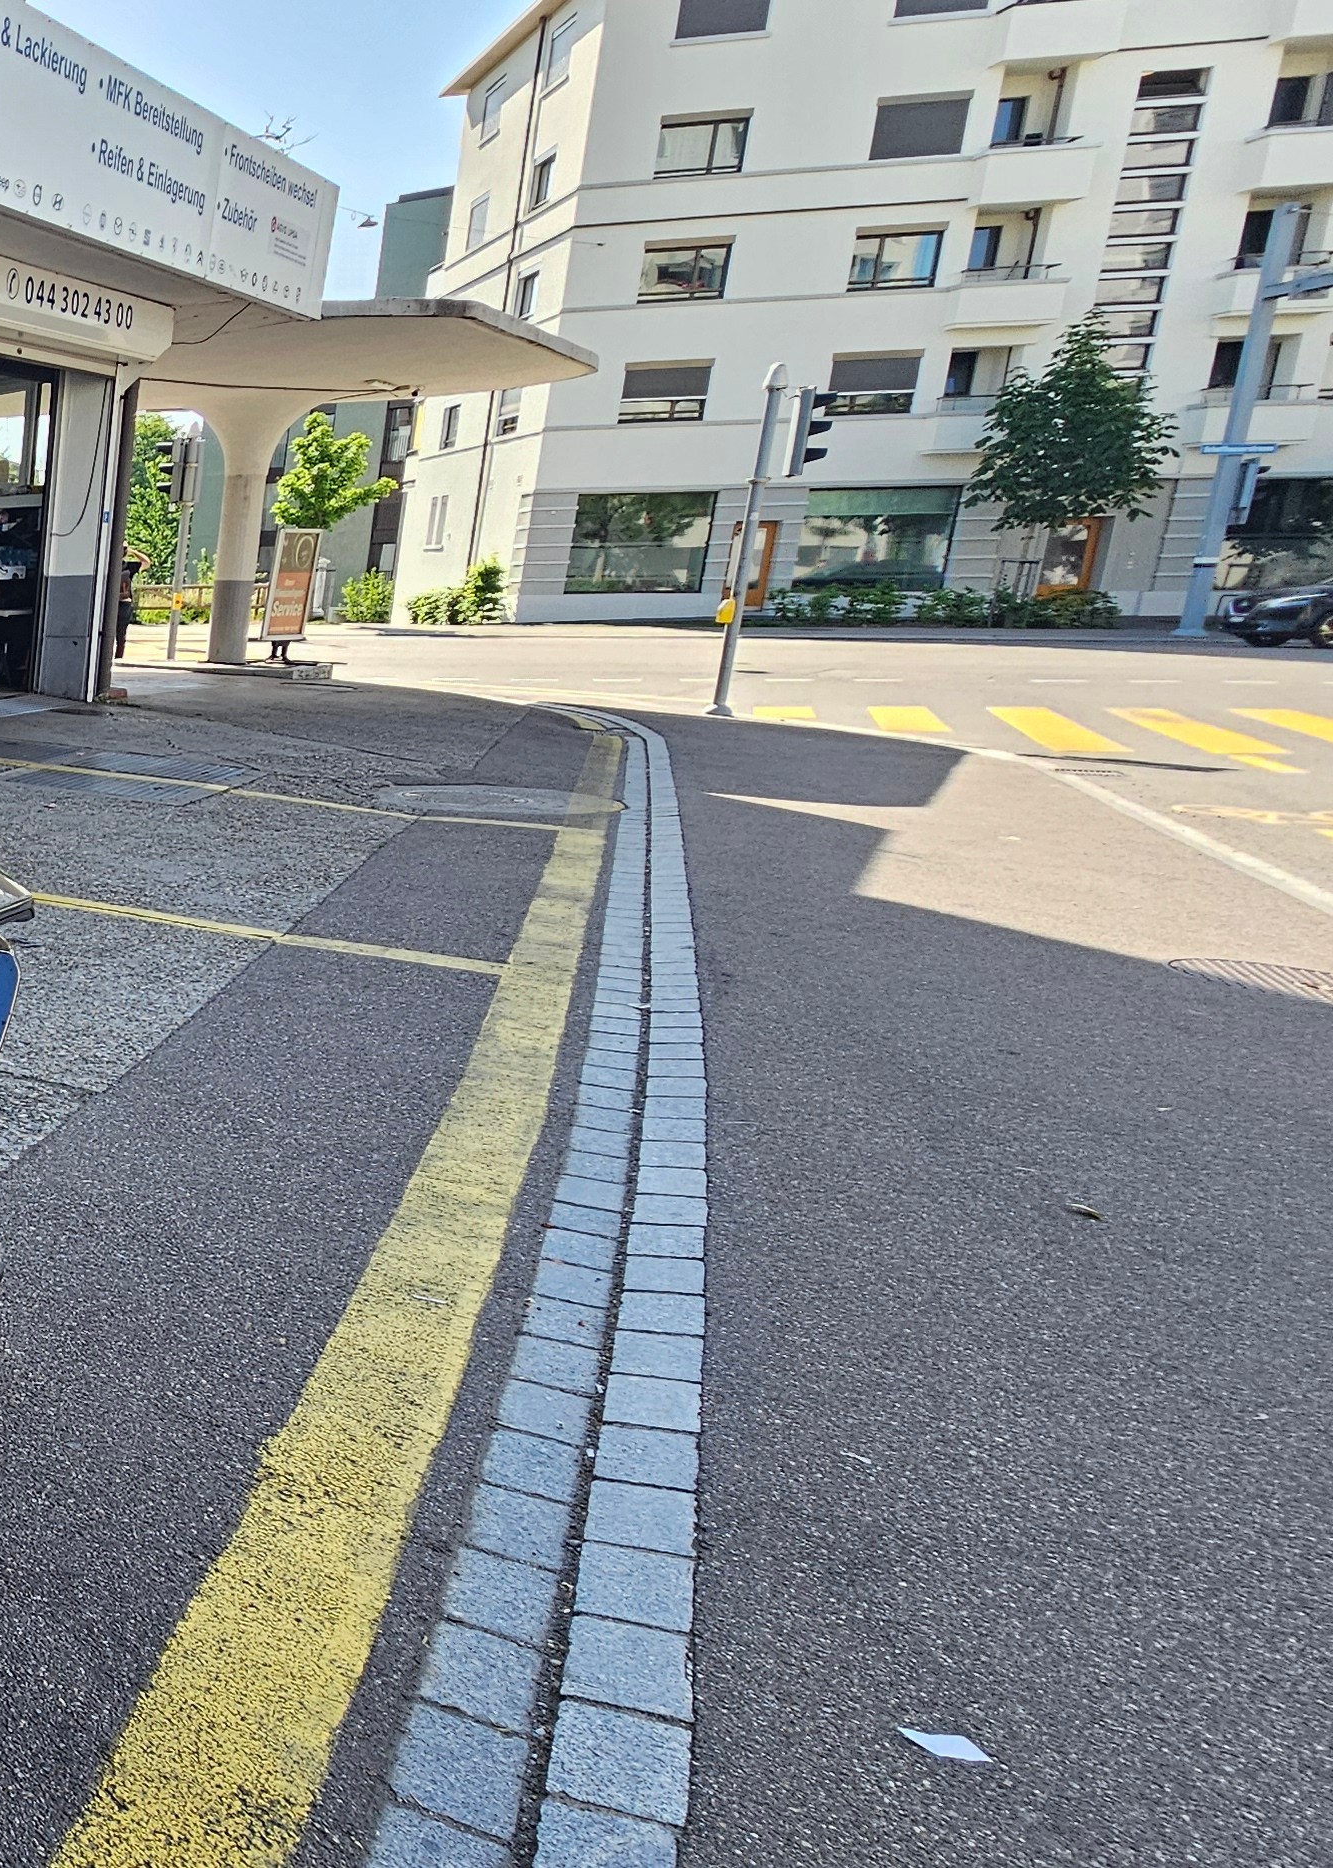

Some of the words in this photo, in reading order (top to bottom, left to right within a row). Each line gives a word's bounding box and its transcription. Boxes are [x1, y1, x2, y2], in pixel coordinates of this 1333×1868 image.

[1, 16, 11, 48] &
[15, 24, 88, 95] Lackierung
[105, 74, 134, 112] MFK
[134, 90, 204, 155] Bereitstellung
[98, 138, 134, 179] Reifen
[136, 157, 144, 183] &
[147, 159, 206, 216] Einlagerung
[229, 143, 287, 194] Frontscheiben
[221, 197, 258, 233] Zubehör
[25, 276, 56, 310] 044
[60, 286, 90, 319] 302
[93, 296, 112, 325] 43
[116, 302, 133, 330] 00
[272, 600, 303, 617] Service
